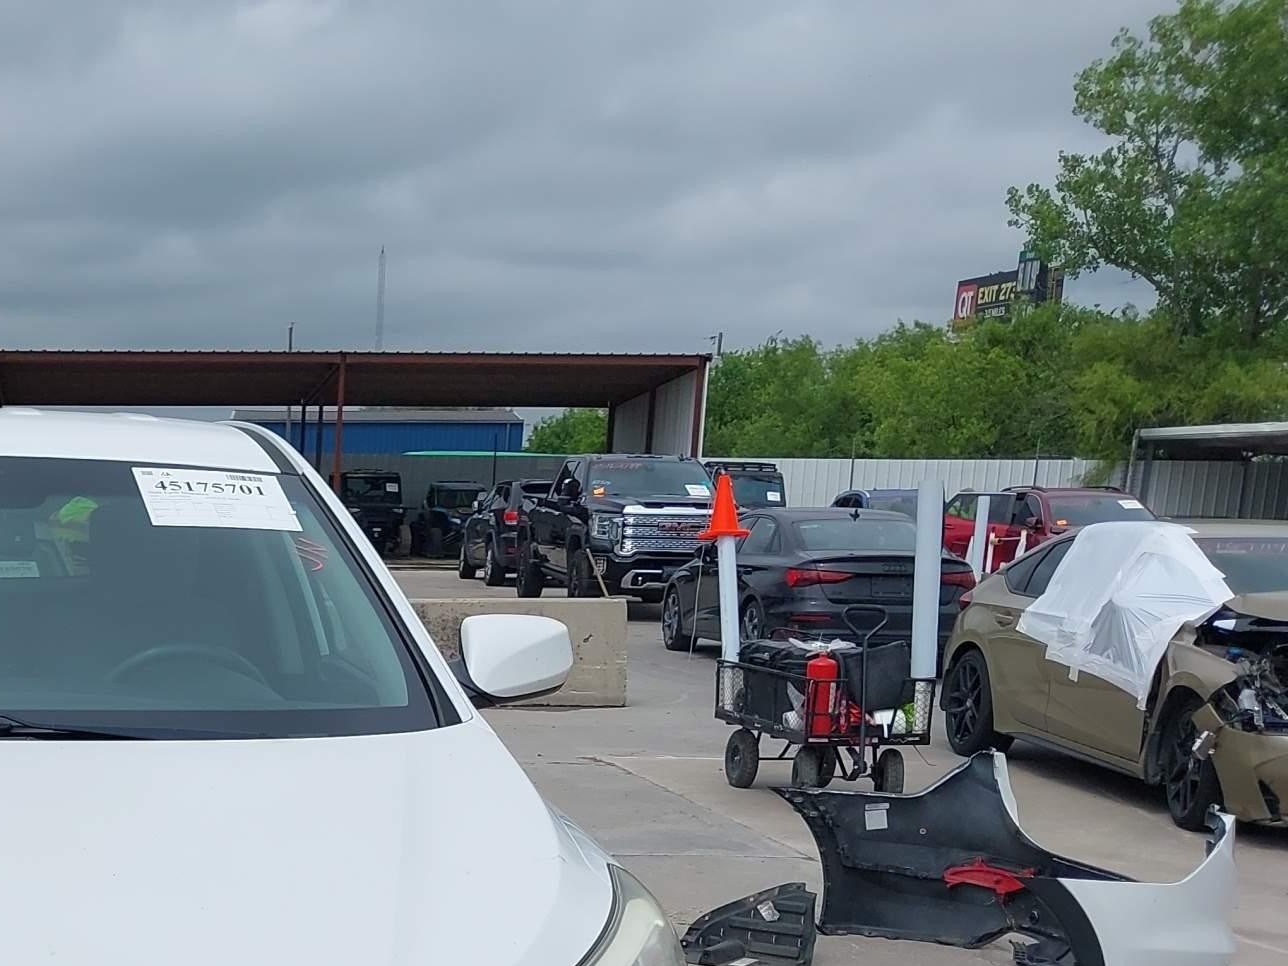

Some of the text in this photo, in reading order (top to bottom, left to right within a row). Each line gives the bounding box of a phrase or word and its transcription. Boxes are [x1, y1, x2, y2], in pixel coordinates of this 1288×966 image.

[977, 284, 999, 304] EXIT
[957, 291, 974, 320] QT
[154, 480, 265, 496] 45175701
